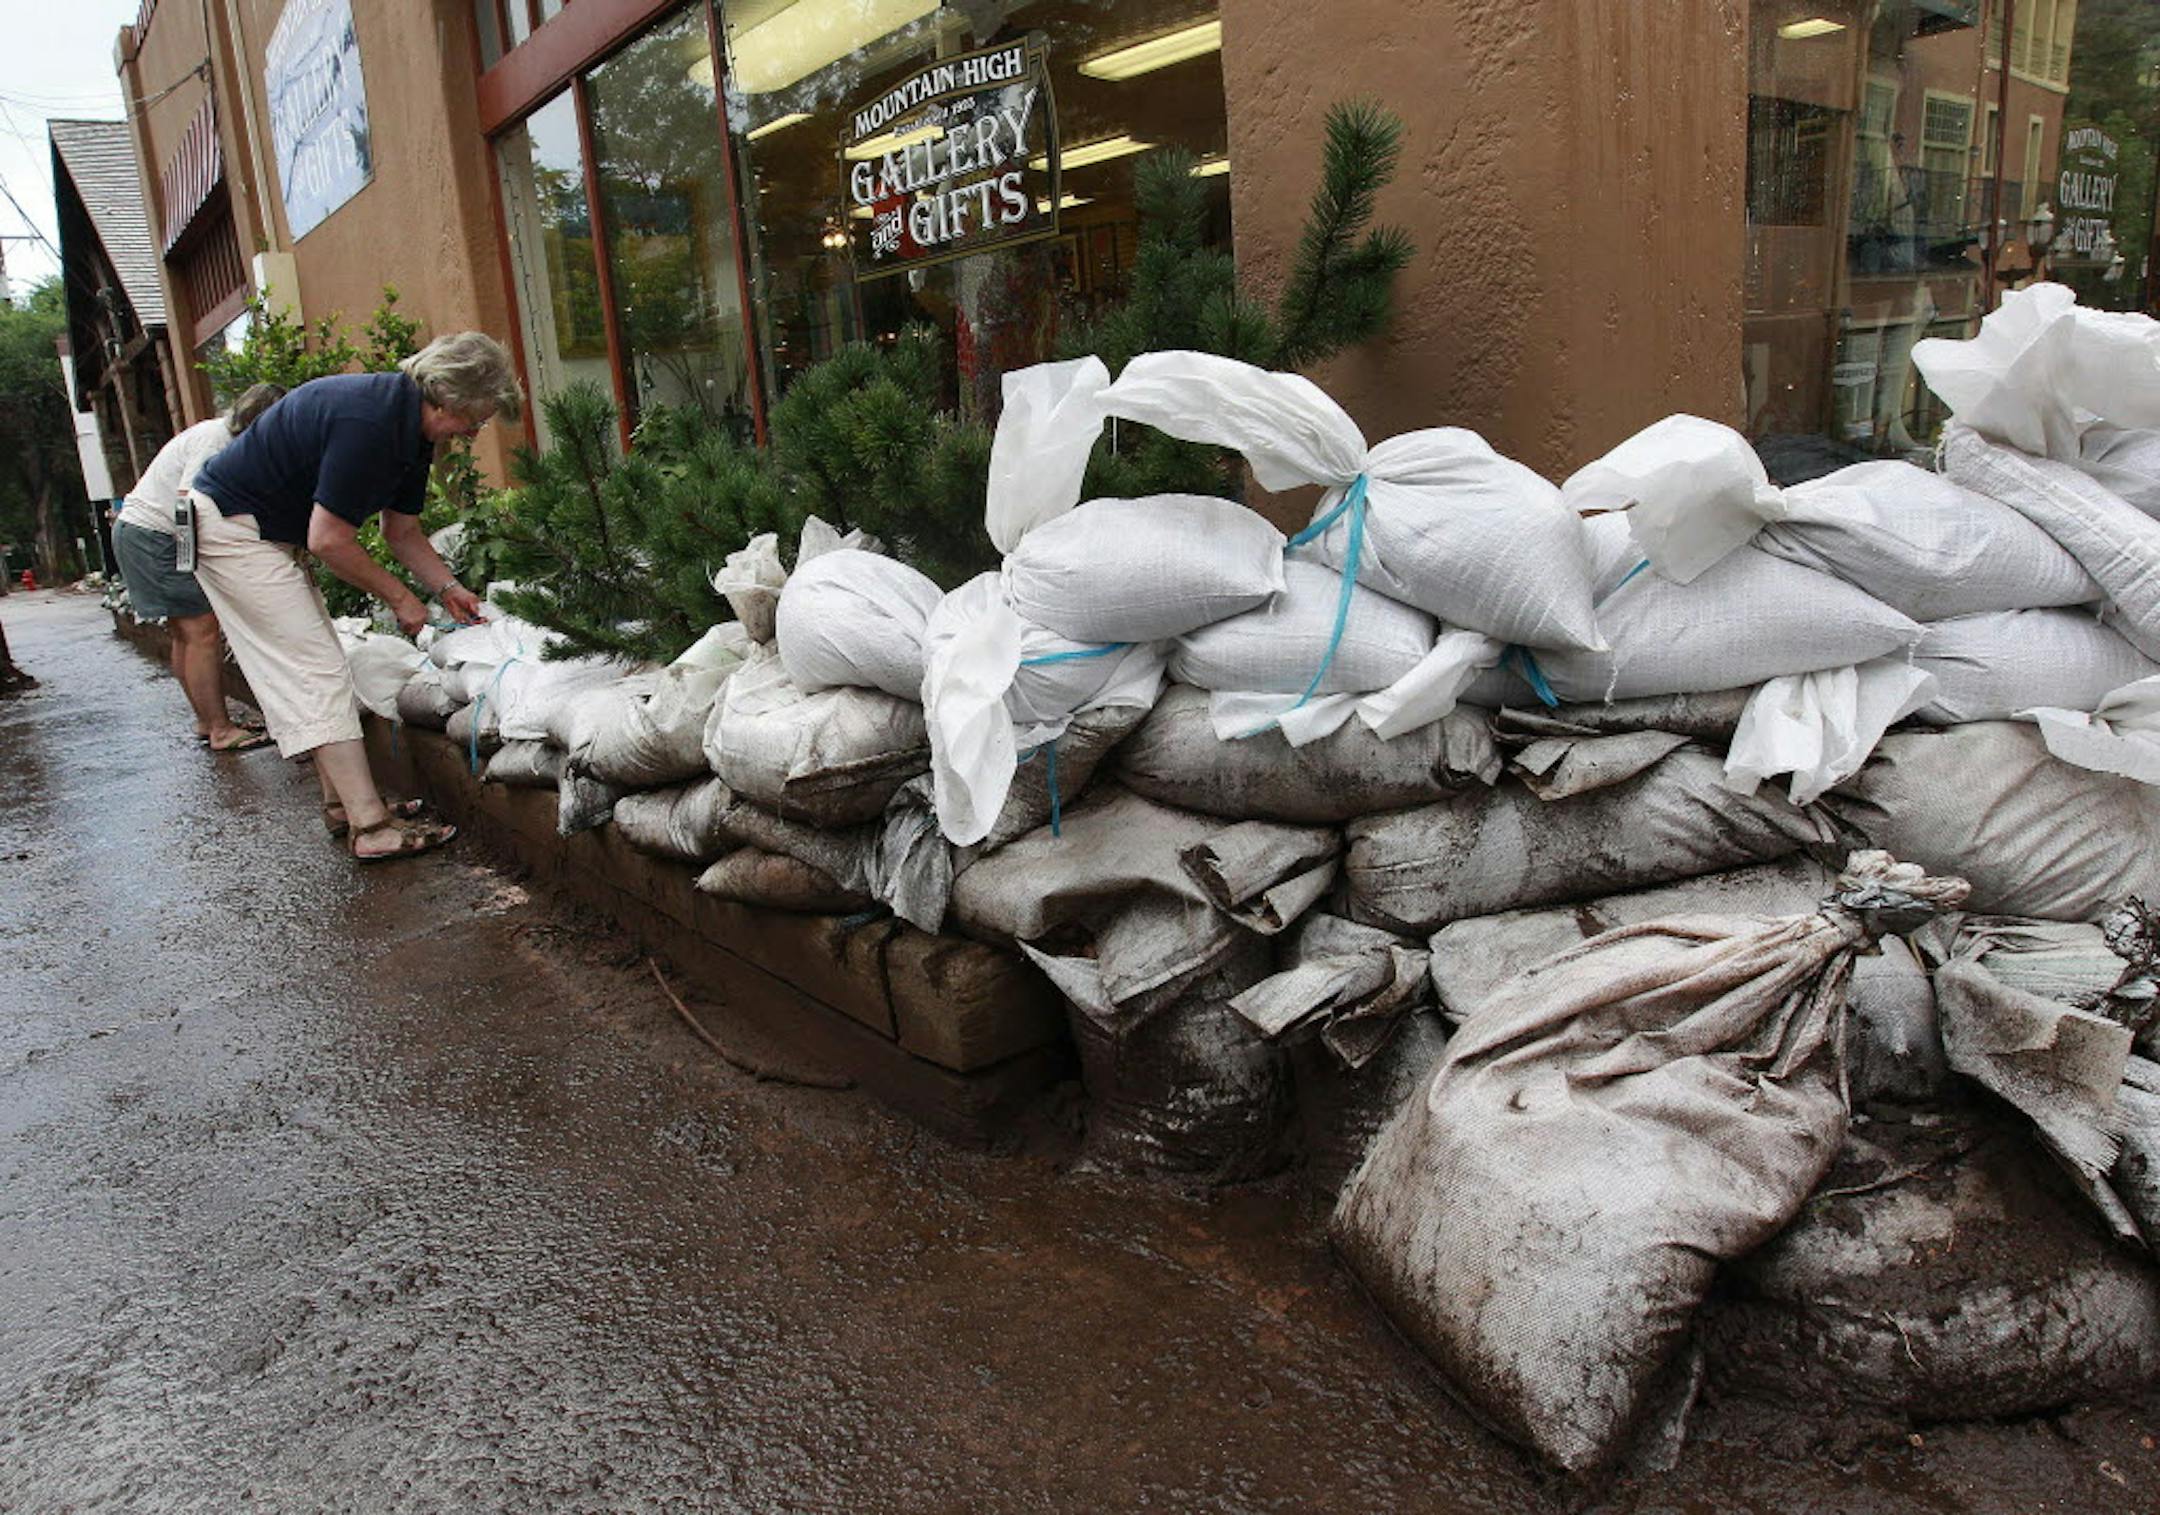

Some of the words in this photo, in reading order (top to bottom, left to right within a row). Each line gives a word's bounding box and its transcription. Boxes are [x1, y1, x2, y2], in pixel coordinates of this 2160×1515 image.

[854, 64, 955, 139] MOUNTAIN
[962, 48, 1023, 86] HIGH
[851, 86, 1038, 206] GALLERY
[870, 205, 904, 250] and
[908, 171, 1028, 246] GIFTS
[2060, 171, 2119, 213] GALLERY
